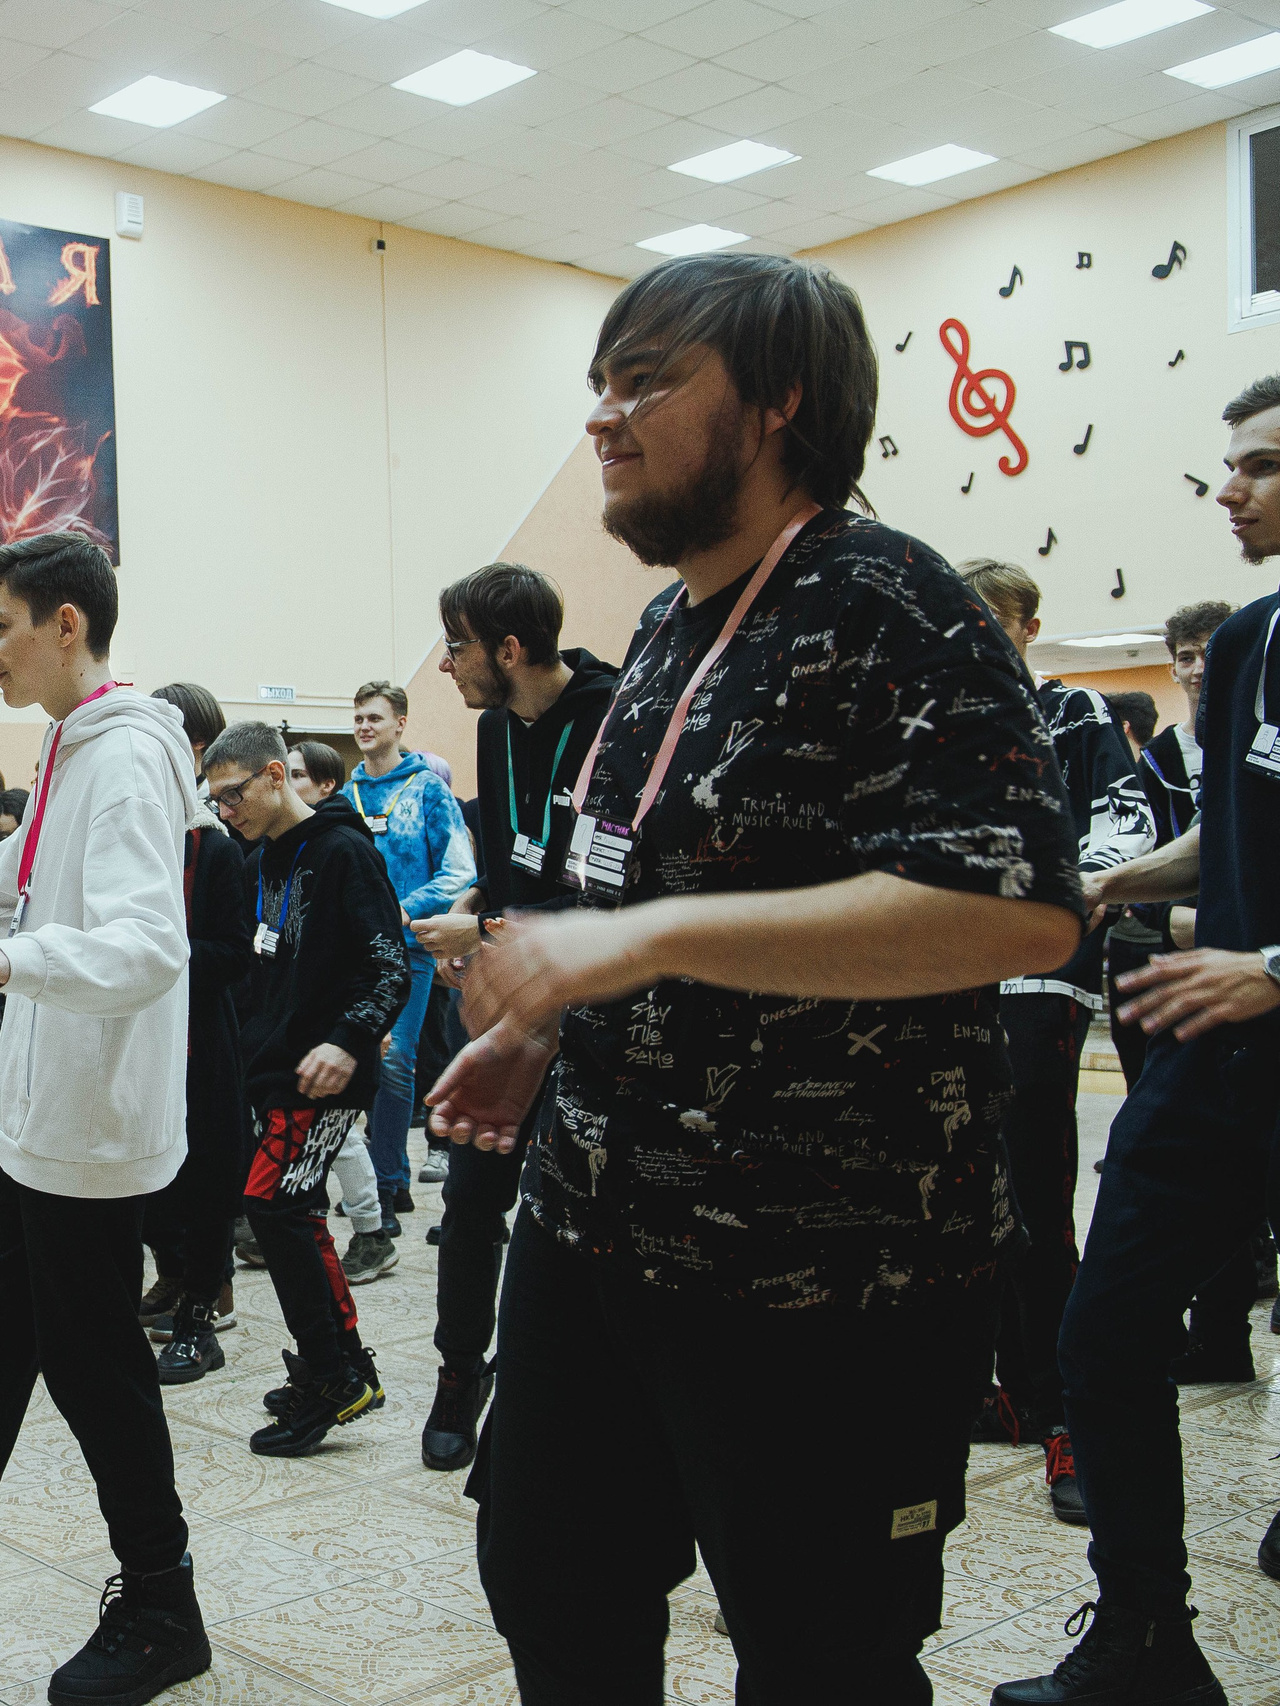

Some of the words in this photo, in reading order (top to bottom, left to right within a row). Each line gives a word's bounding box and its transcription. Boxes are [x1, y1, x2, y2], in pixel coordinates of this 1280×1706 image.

[261, 687, 292, 699] ЫХОД
[741, 797, 786, 814] TRUTH
[799, 802, 825, 817] AND
[731, 812, 771, 828] MUSIC
[782, 815, 814, 831] RULE
[631, 1002, 672, 1025] STAY
[787, 1081, 805, 1091] BE
[804, 1080, 842, 1091] BRAVE
[943, 1083, 966, 1099] MY
[772, 1090, 795, 1099] BIG
[794, 1089, 847, 1099] THOUGHTS
[571, 1133, 602, 1151] MOOD
[585, 1127, 606, 1142] MY
[797, 1130, 825, 1144] AND
[782, 1142, 813, 1157] RULE
[752, 1266, 816, 1290] FREEDOM
